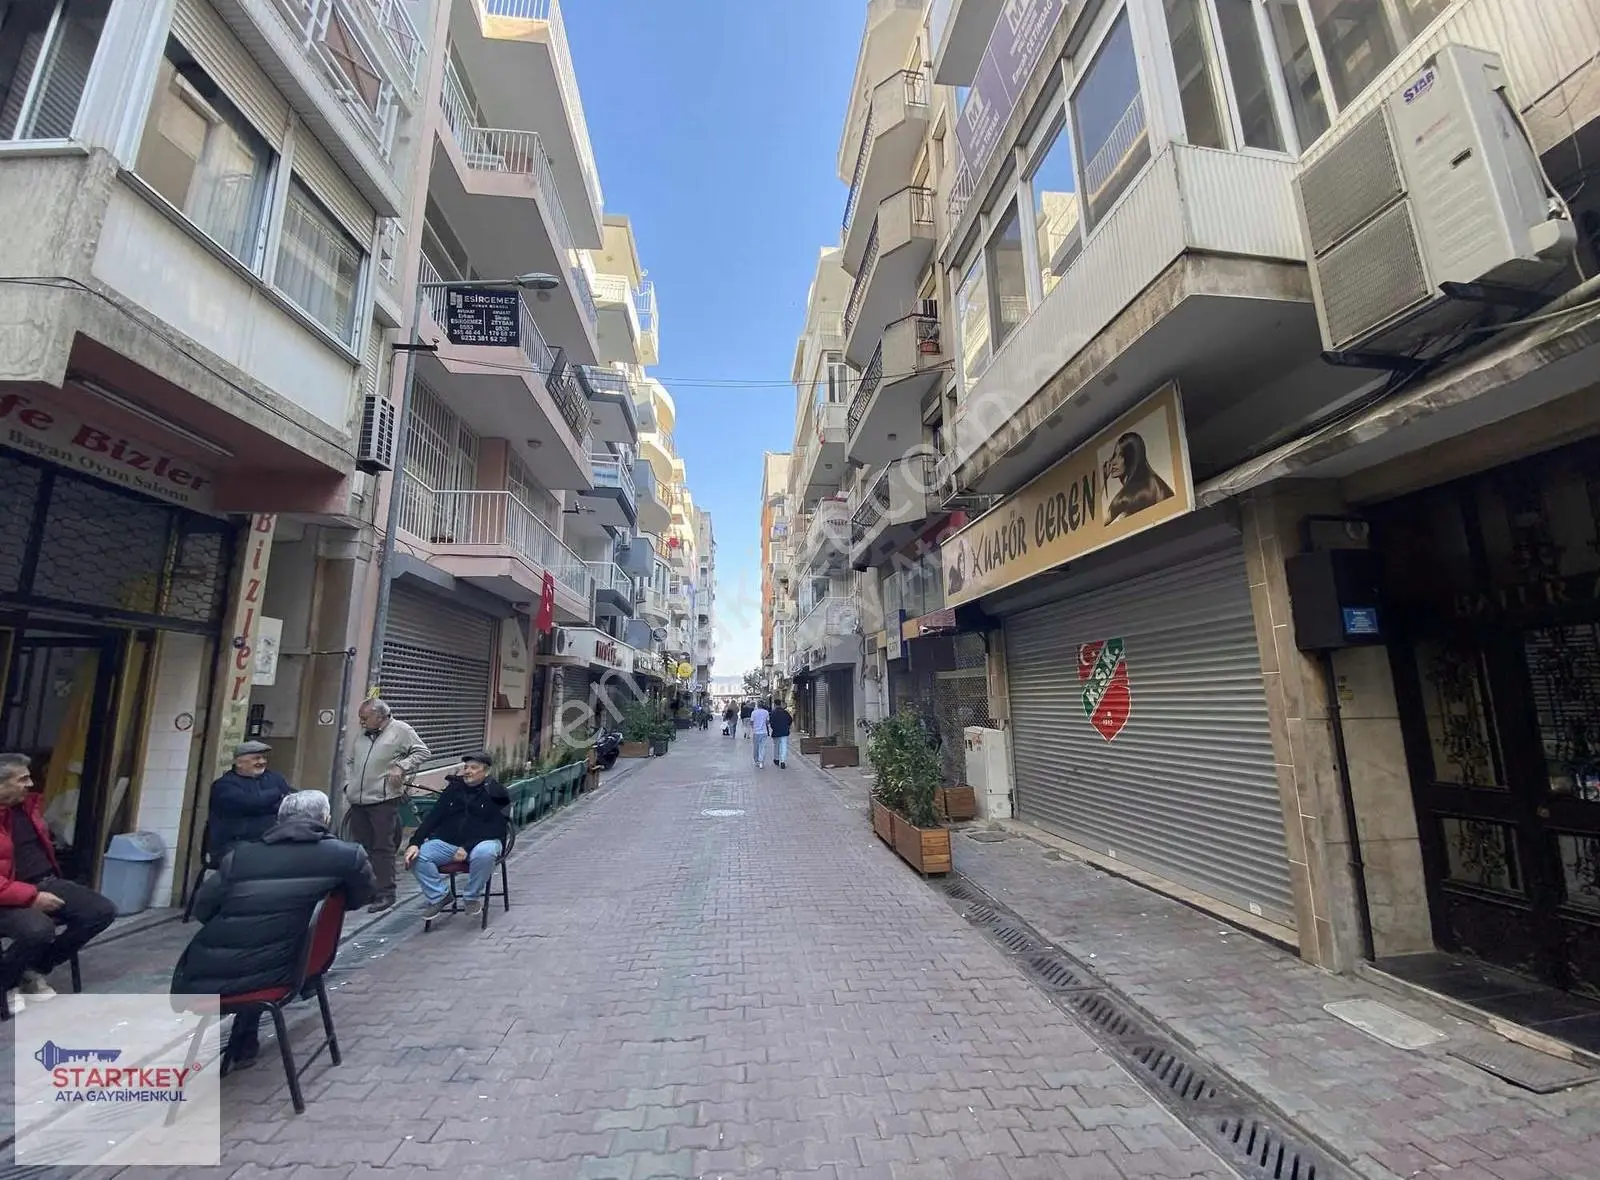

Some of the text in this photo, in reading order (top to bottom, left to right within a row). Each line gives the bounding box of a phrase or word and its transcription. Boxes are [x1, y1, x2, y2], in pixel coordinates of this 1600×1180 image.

[1403, 70, 1435, 103] STAR
[464, 294, 516, 305] ESİRGEMEZ
[8, 428, 73, 461] Bayan
[79, 453, 130, 483] Oyun
[71, 423, 212, 491] Bizler
